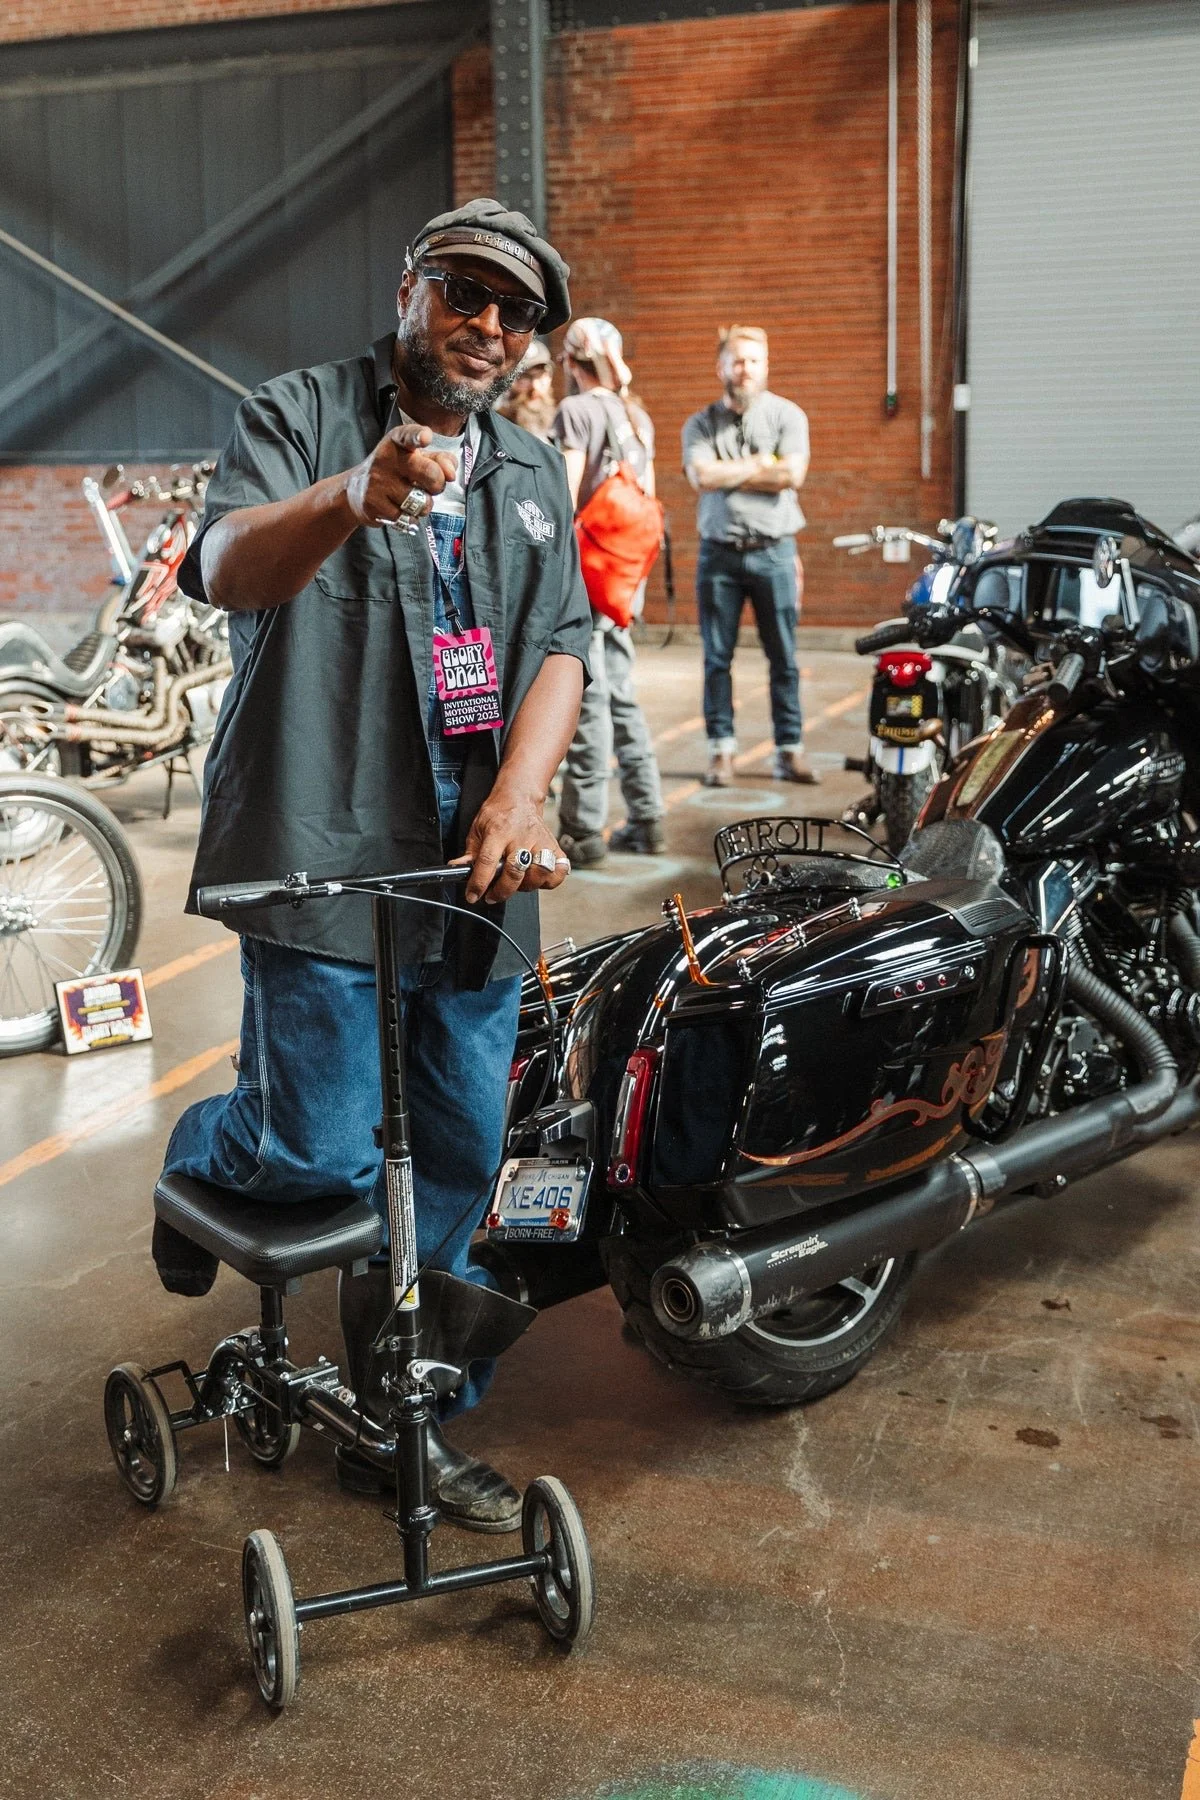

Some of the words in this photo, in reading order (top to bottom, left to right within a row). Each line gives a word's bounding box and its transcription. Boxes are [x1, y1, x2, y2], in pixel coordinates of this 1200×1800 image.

[473, 233, 535, 267] DETROIT
[442, 644, 483, 667] GLORY
[444, 663, 487, 690] DAZE
[443, 695, 497, 710] INVITATIONAL
[444, 702, 499, 717] MOTORCYCLE
[445, 713, 475, 727] SHOW
[477, 710, 500, 721] 2025
[720, 820, 830, 857] DETROIT
[507, 1186, 573, 1209] XE406
[509, 1228, 554, 1239] BORN-FREE
[767, 1234, 819, 1264] Screamin'
[798, 1241, 828, 1258] Eagle
